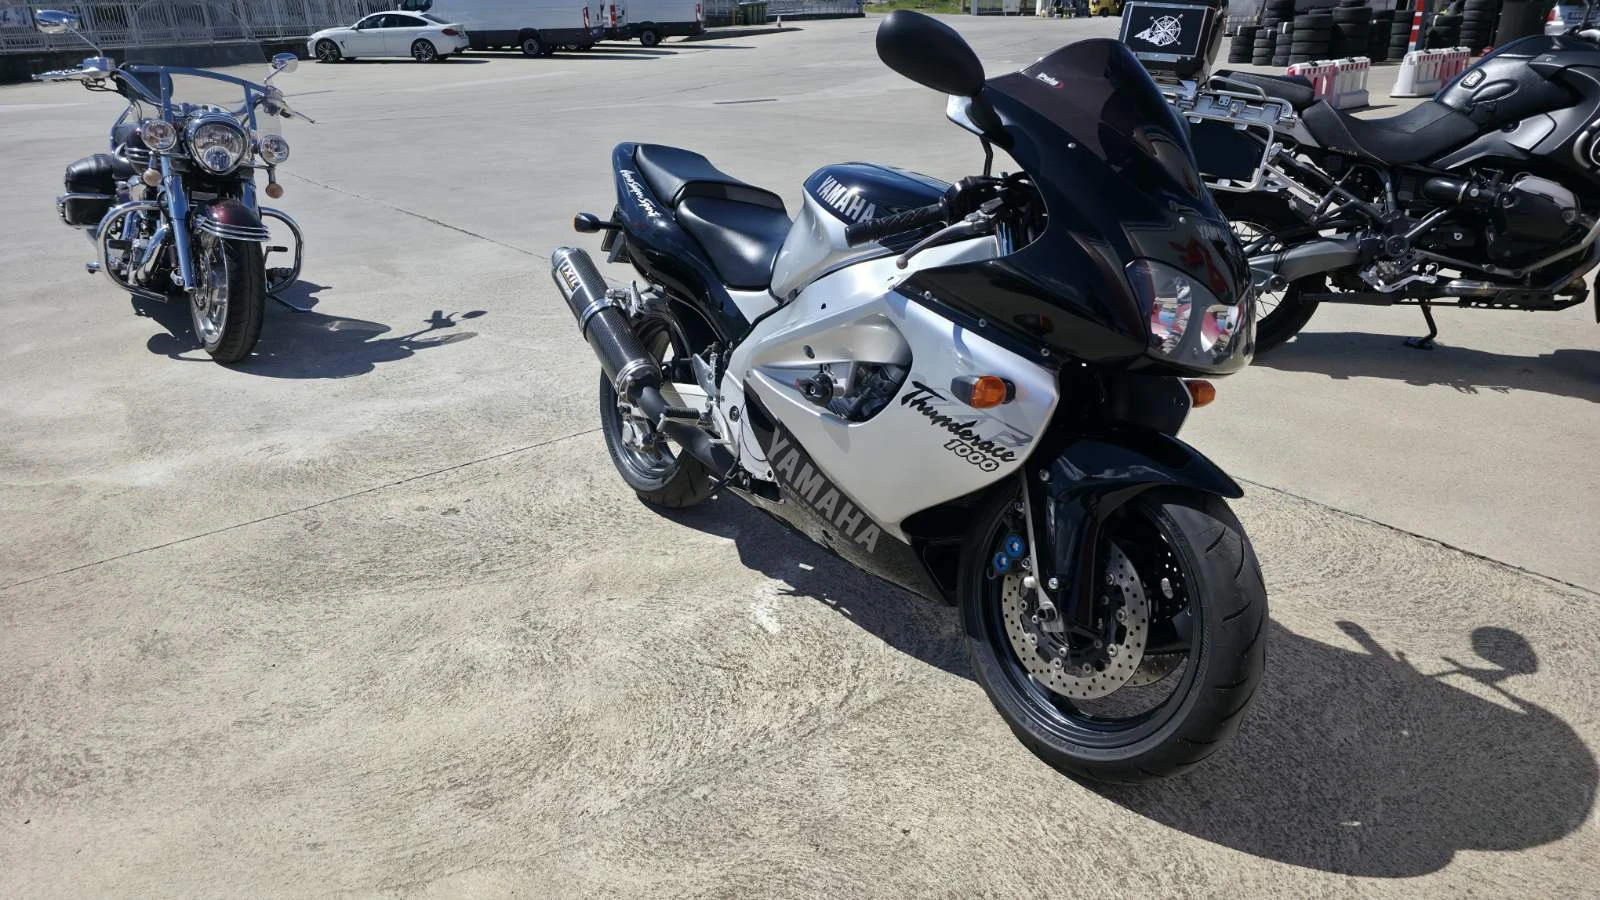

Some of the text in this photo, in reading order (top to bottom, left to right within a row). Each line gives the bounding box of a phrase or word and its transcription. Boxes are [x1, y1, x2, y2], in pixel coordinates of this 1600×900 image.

[816, 175, 876, 224] YAMAHA
[901, 381, 1018, 462] Thunderace
[943, 439, 1000, 472] 1000
[766, 425, 881, 553] YAMAHA
